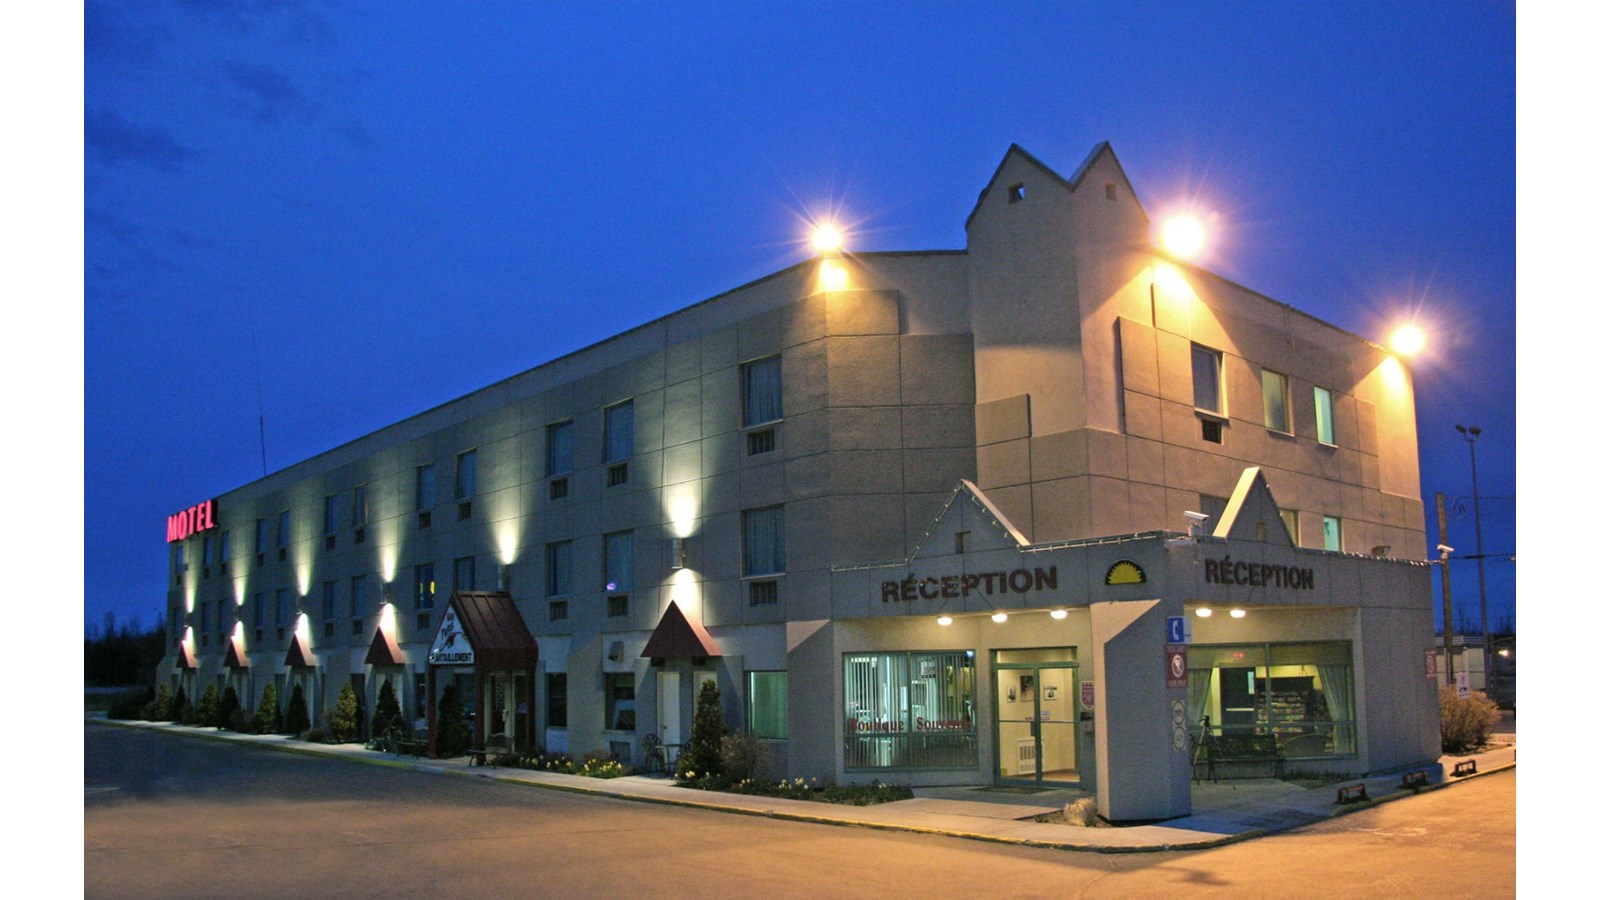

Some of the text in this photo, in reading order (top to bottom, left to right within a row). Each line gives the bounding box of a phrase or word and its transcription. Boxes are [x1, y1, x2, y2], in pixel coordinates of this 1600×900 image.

[166, 499, 214, 543] MOTEL
[881, 565, 1058, 602] RÉCEPTION
[1205, 555, 1315, 590] RÉCEPTION
[848, 717, 905, 734] Boutique
